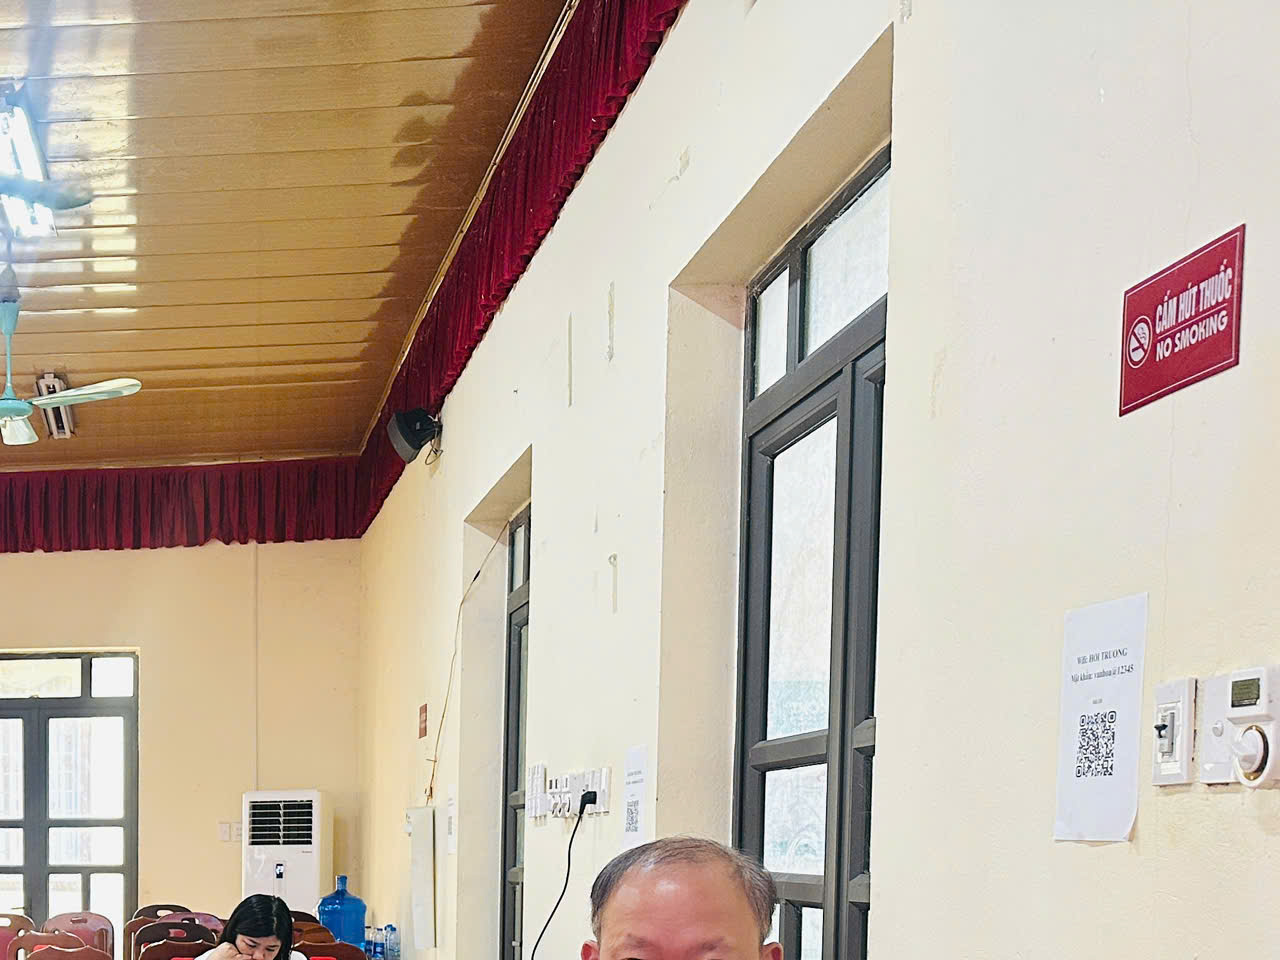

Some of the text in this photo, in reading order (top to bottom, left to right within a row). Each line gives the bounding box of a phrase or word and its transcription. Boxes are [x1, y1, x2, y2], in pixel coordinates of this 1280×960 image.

[1155, 259, 1233, 334] CẤM HÚT THUỐC
[1155, 310, 1229, 362] NO SMOKING
